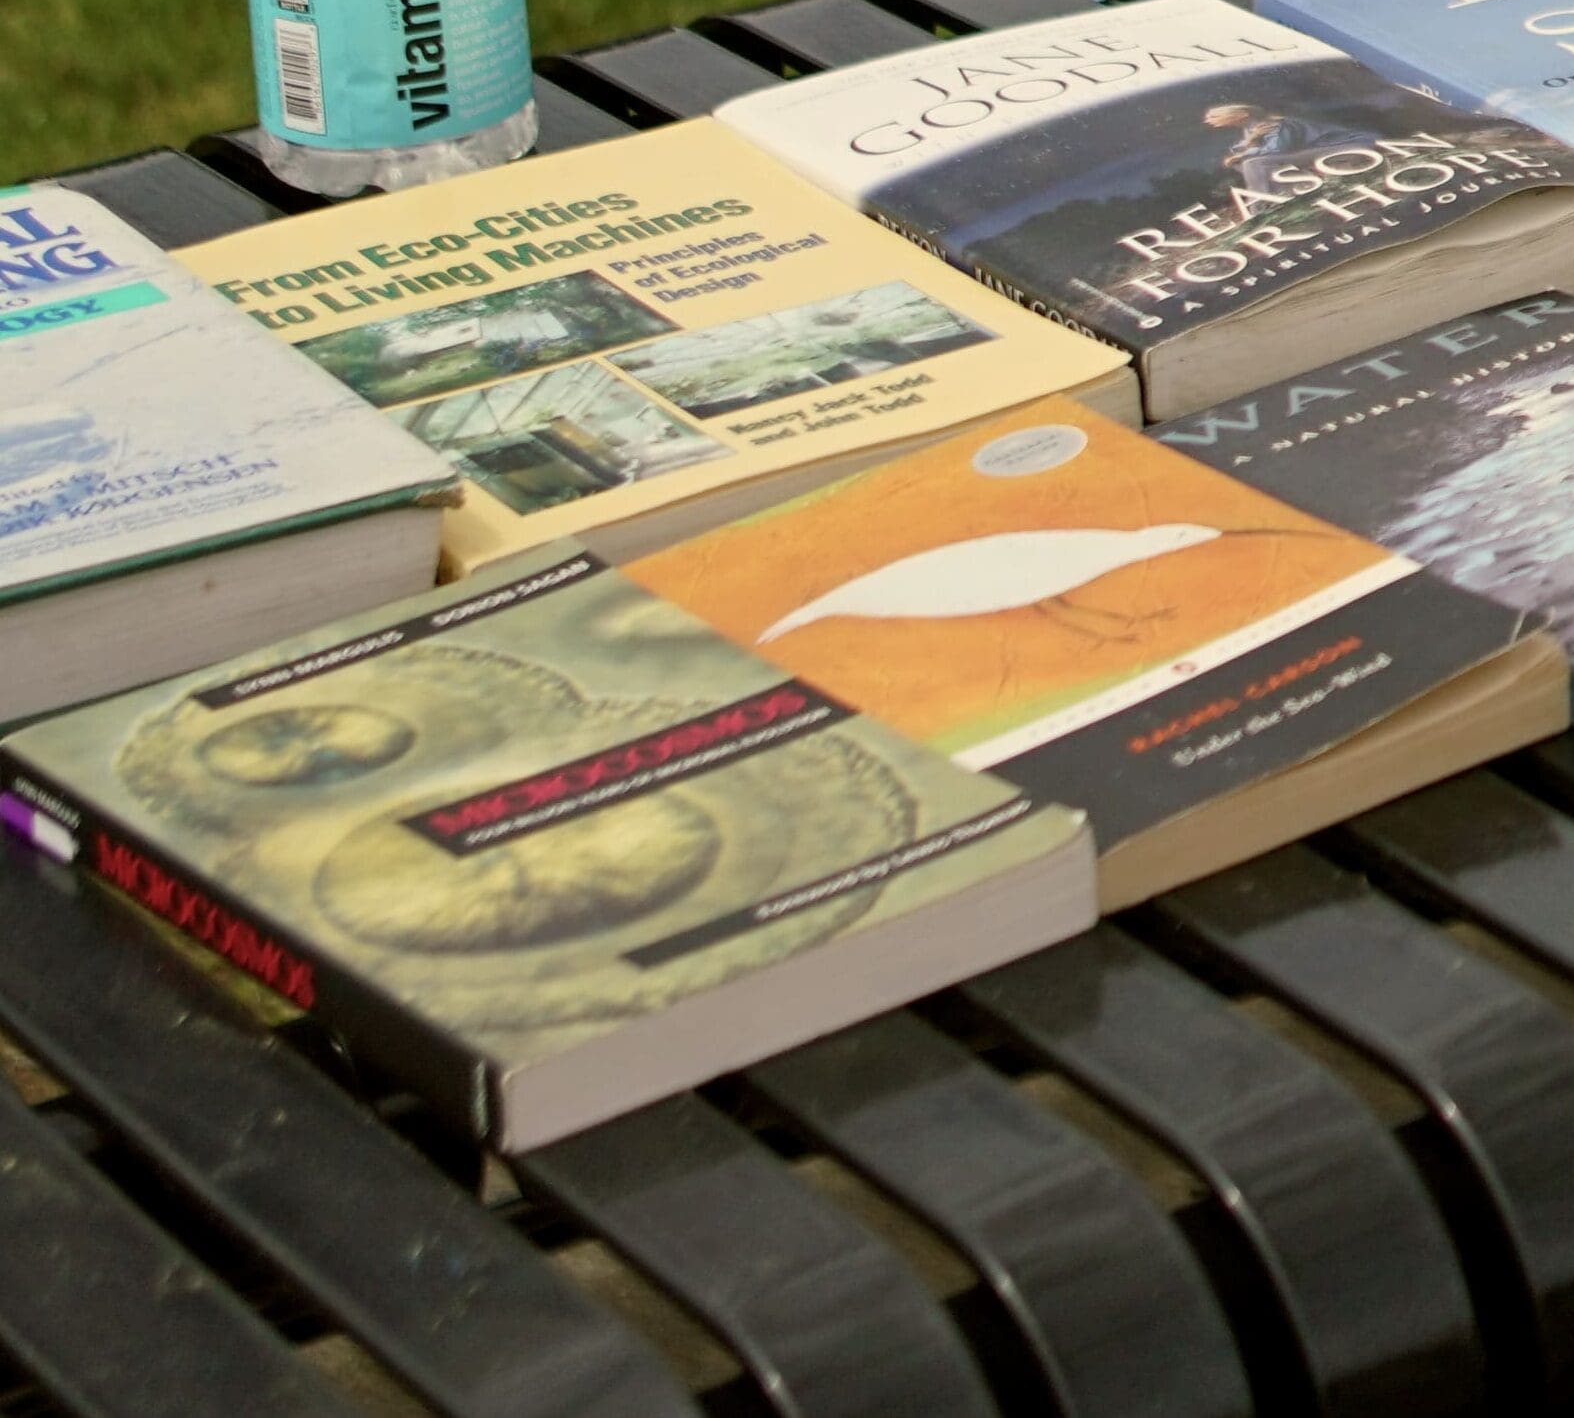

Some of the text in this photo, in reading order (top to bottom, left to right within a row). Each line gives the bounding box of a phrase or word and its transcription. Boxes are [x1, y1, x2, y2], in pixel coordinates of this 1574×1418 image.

[849, 34, 1299, 157] GOODALL
[911, 34, 1139, 102] JANE
[1115, 131, 1456, 263] REASON
[1124, 224, 1322, 303] FOR
[1312, 147, 1550, 224] HOPE
[1184, 300, 1205, 313] A
[1220, 218, 1401, 298] SPIRITUAL
[1419, 169, 1563, 213] JOURNEY
[213, 192, 640, 305] From Eco-Cities
[246, 198, 756, 330] to Living Machines
[607, 229, 766, 275] Principles
[633, 232, 830, 290] of Ecological
[652, 270, 764, 304] Design
[725, 372, 937, 435] Nancy Jack Todd
[749, 392, 926, 446] and John Todd
[1232, 452, 1253, 467] A
[1270, 387, 1437, 453] NATURAL
[1126, 696, 1242, 754] RACHEL
[1170, 650, 1394, 767] Under the Sea-Wind
[427, 687, 808, 837] MICROCOSMOS
